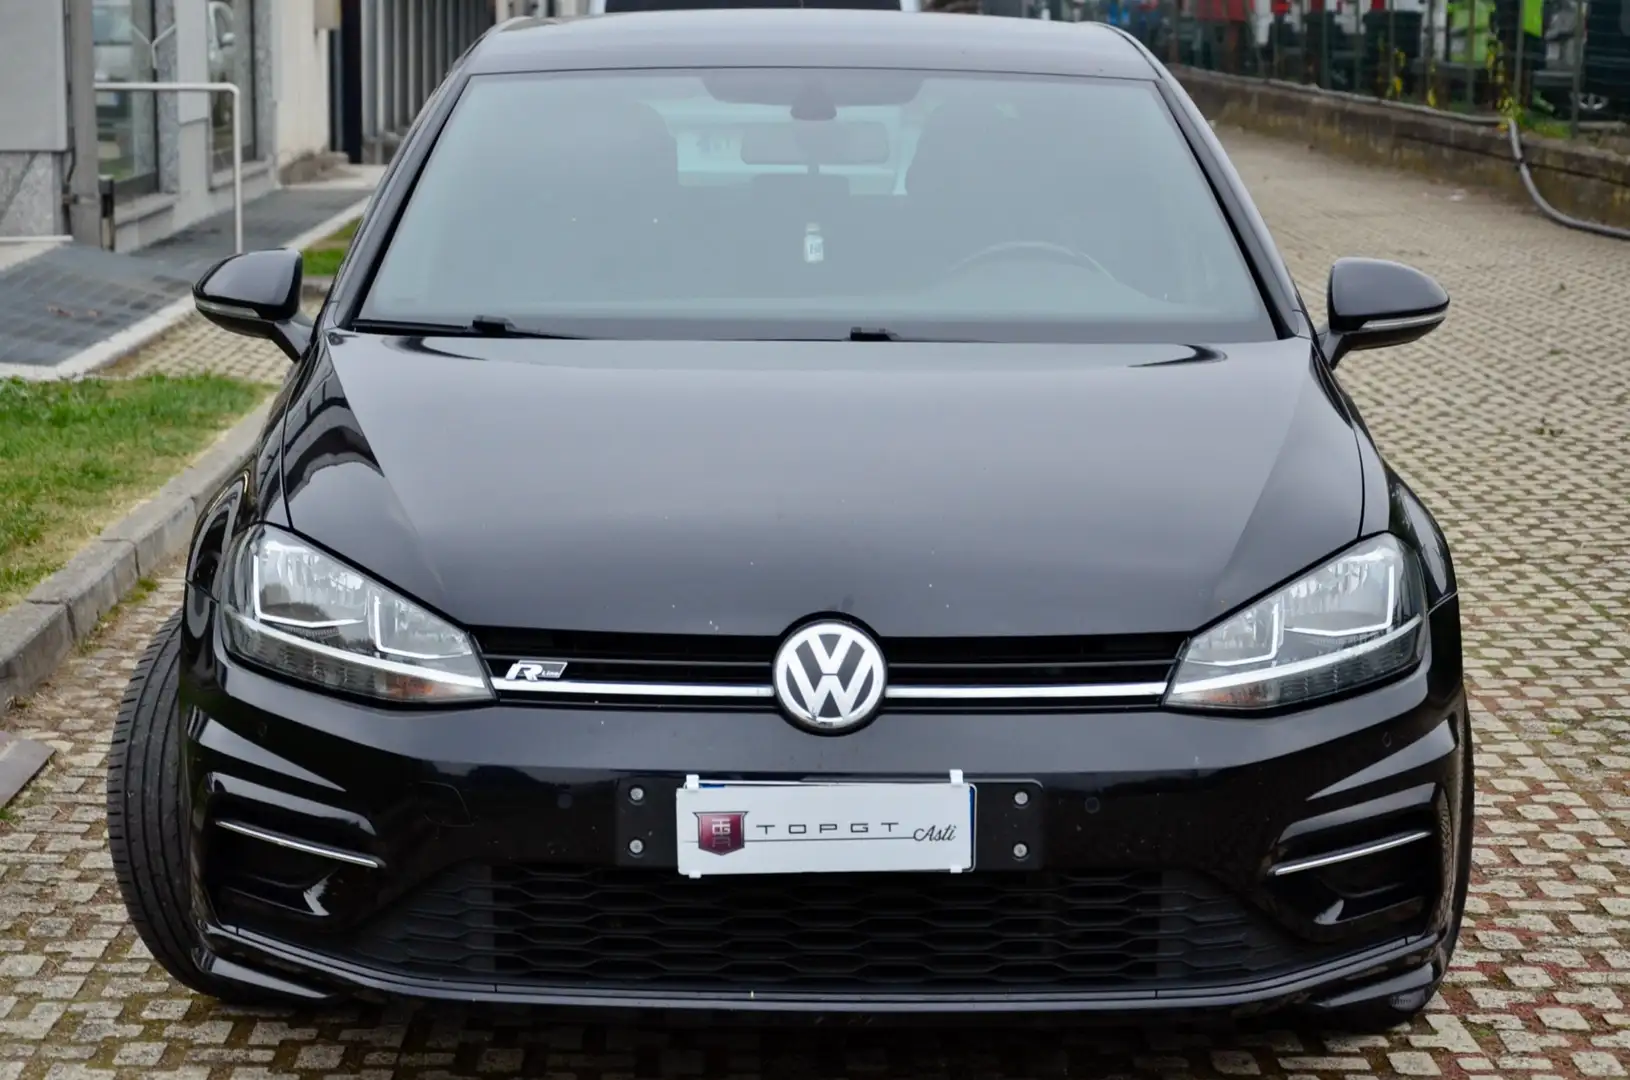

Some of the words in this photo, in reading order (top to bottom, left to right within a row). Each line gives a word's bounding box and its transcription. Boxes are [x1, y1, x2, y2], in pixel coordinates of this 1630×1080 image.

[505, 663, 543, 681] R
[777, 623, 883, 727] VW
[756, 822, 899, 835] TOPGT
[913, 824, 957, 841] Asti
